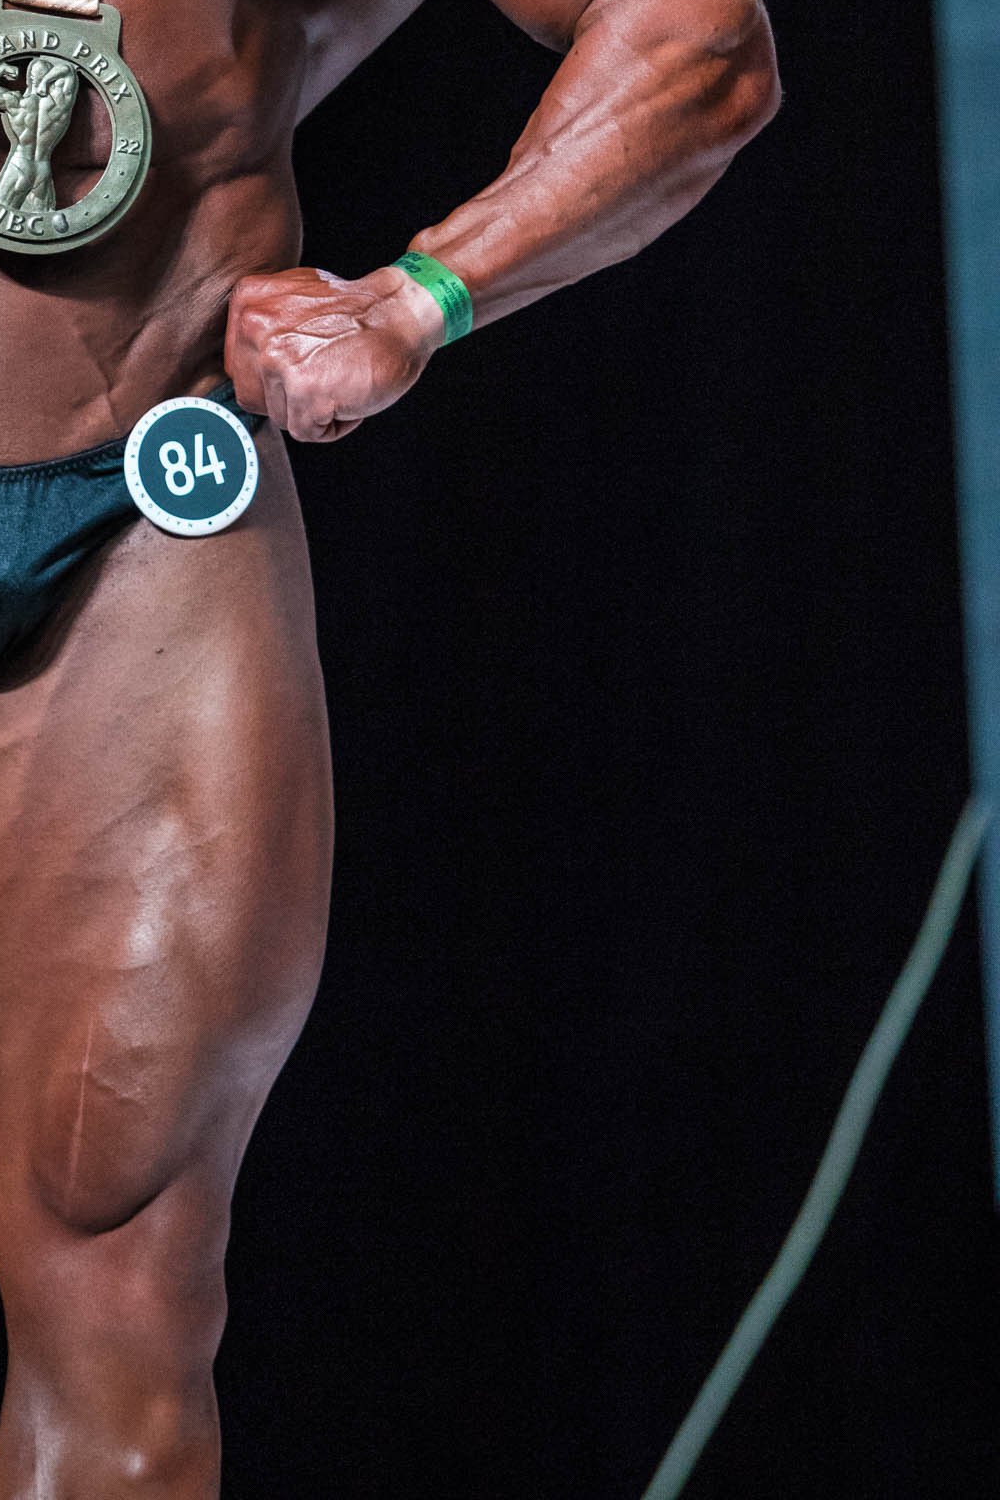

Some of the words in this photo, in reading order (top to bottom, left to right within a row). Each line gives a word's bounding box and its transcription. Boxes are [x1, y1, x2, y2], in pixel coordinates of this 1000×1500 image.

[72, 42, 132, 104] PRIX
[116, 139, 141, 156] 22
[159, 433, 226, 496] 84
